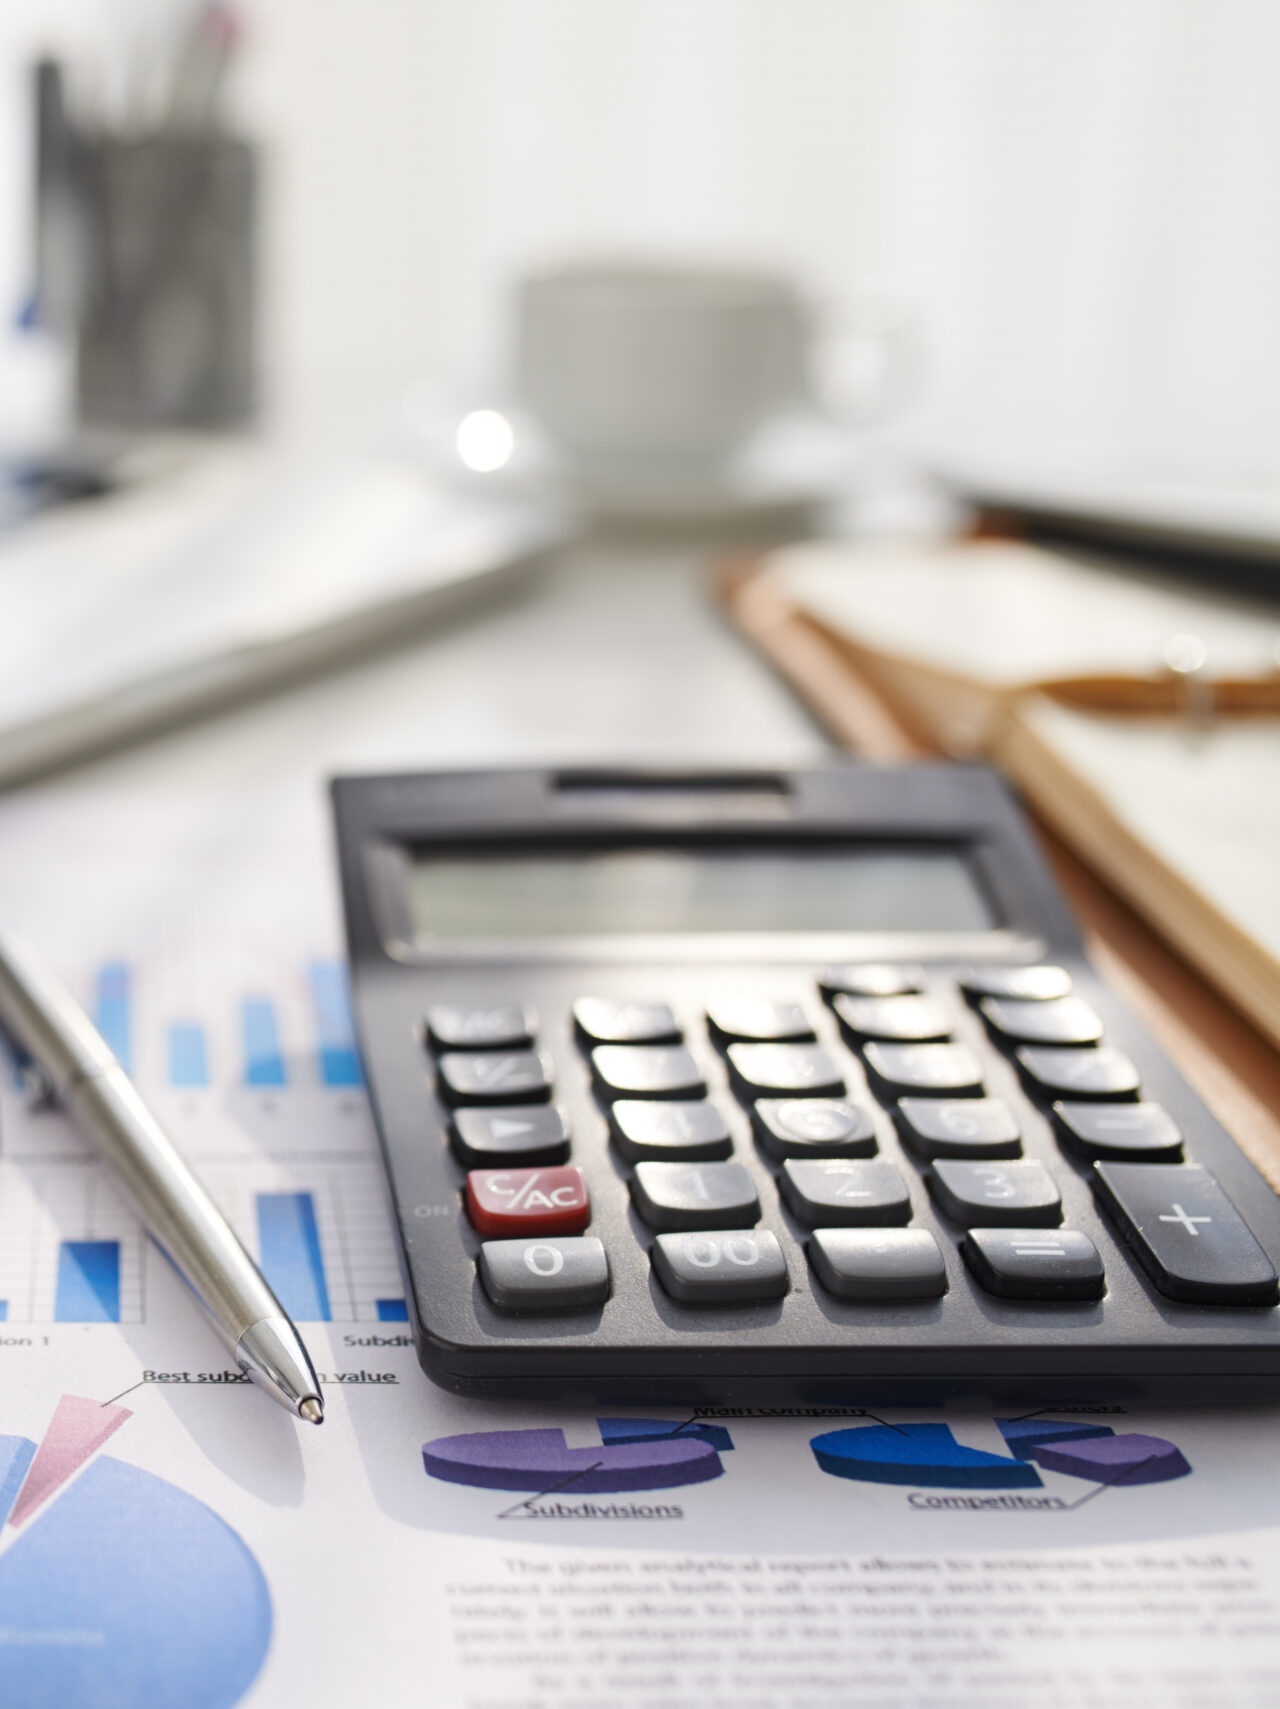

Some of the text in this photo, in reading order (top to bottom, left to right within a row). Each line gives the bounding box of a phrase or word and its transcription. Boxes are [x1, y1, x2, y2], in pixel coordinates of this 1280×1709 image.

[485, 1172, 578, 1211] C/AC
[680, 1171, 710, 1201] 1
[824, 1166, 873, 1198] 2
[972, 1167, 1017, 1199] 3
[414, 1205, 450, 1218] ON
[523, 1244, 565, 1277] 0
[681, 1235, 761, 1268] 00
[41, 1335, 50, 1347] 1
[142, 1369, 191, 1382] Best
[333, 1369, 397, 1382] value
[522, 1500, 684, 1518] Subdivisions
[906, 1492, 1068, 1511] Competitors
